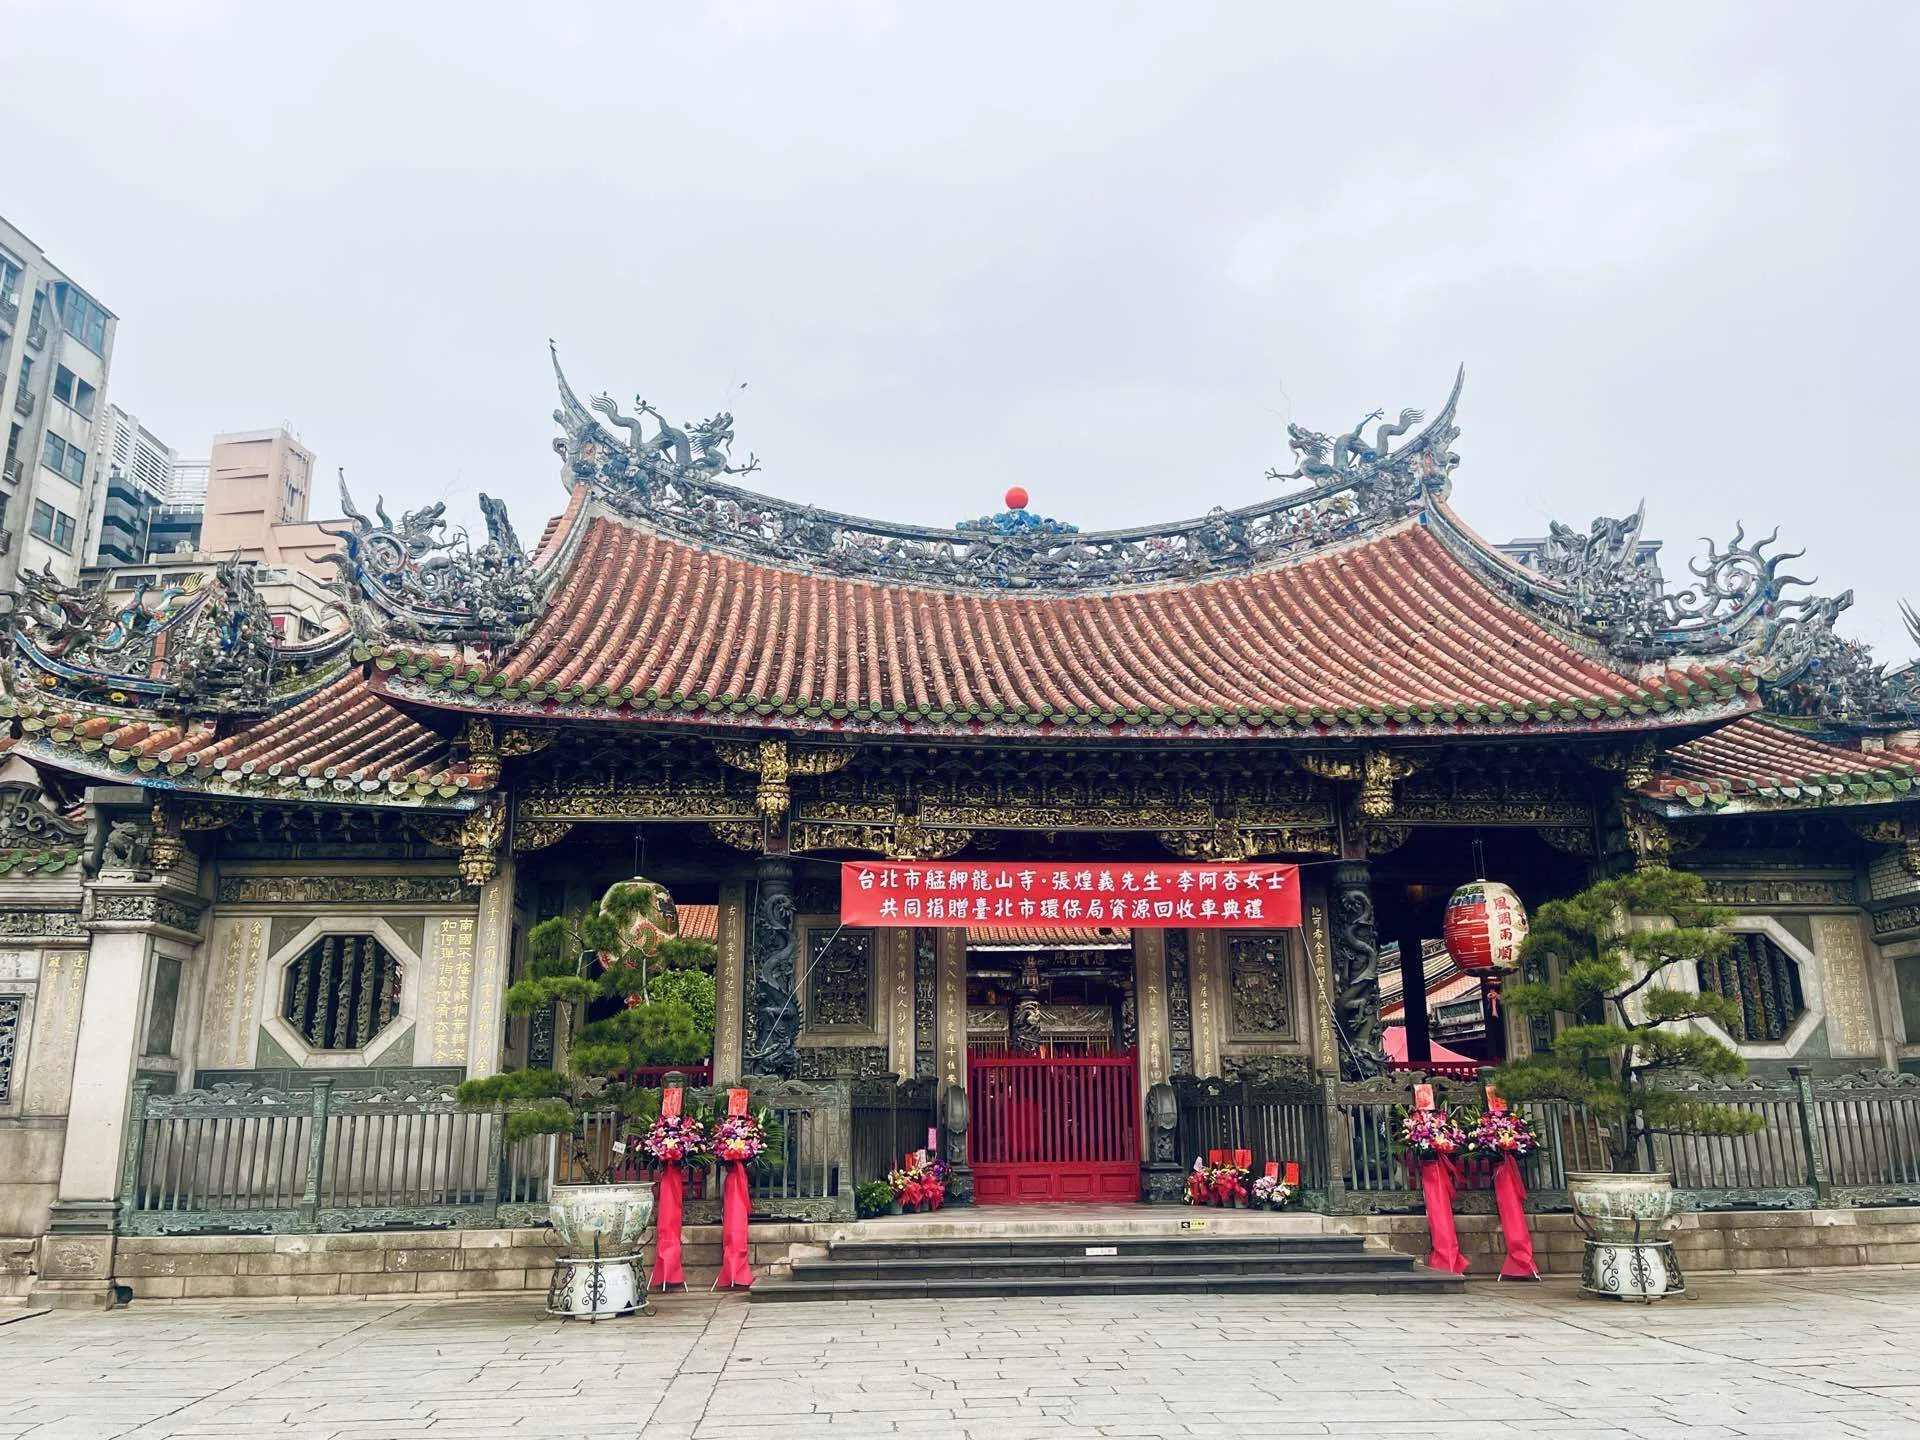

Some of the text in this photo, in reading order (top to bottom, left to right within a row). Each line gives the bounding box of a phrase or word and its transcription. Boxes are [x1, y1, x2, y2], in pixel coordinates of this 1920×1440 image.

[880, 897, 1264, 920] 共同捐贈臺北市環保局資源回收車典禮
